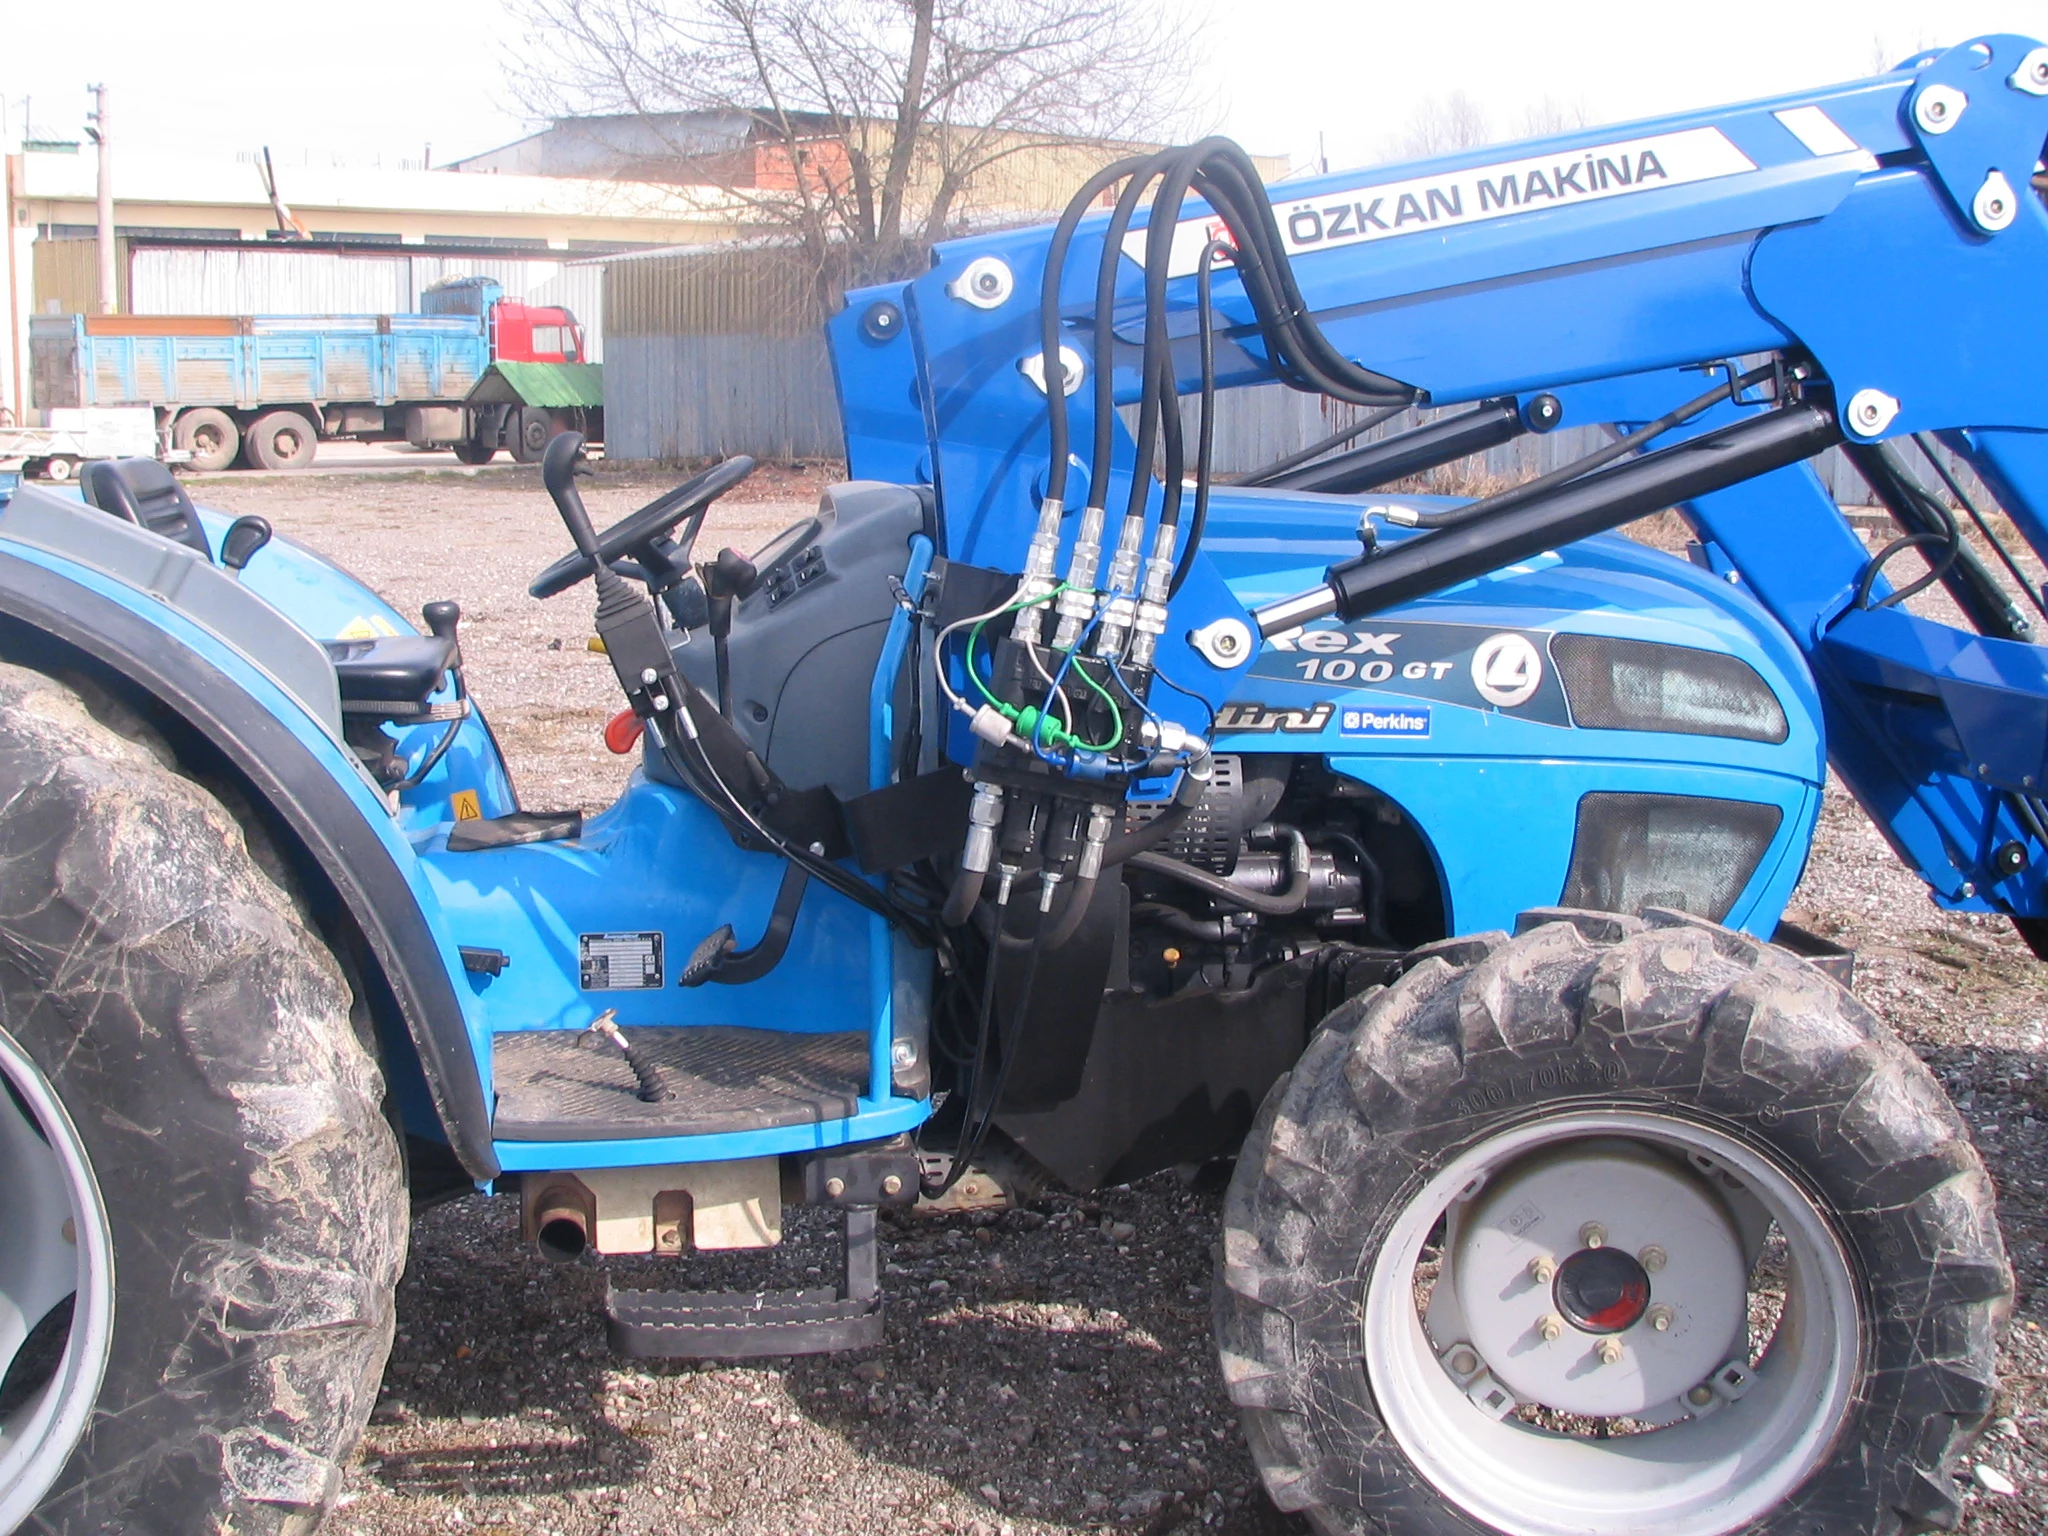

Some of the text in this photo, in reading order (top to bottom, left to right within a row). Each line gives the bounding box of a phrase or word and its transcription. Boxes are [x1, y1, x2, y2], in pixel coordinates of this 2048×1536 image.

[1288, 150, 1668, 246] ÖZKAN MAKİNA
[1295, 658, 1454, 683] 100 GT
[1361, 711, 1426, 731] Perkins
